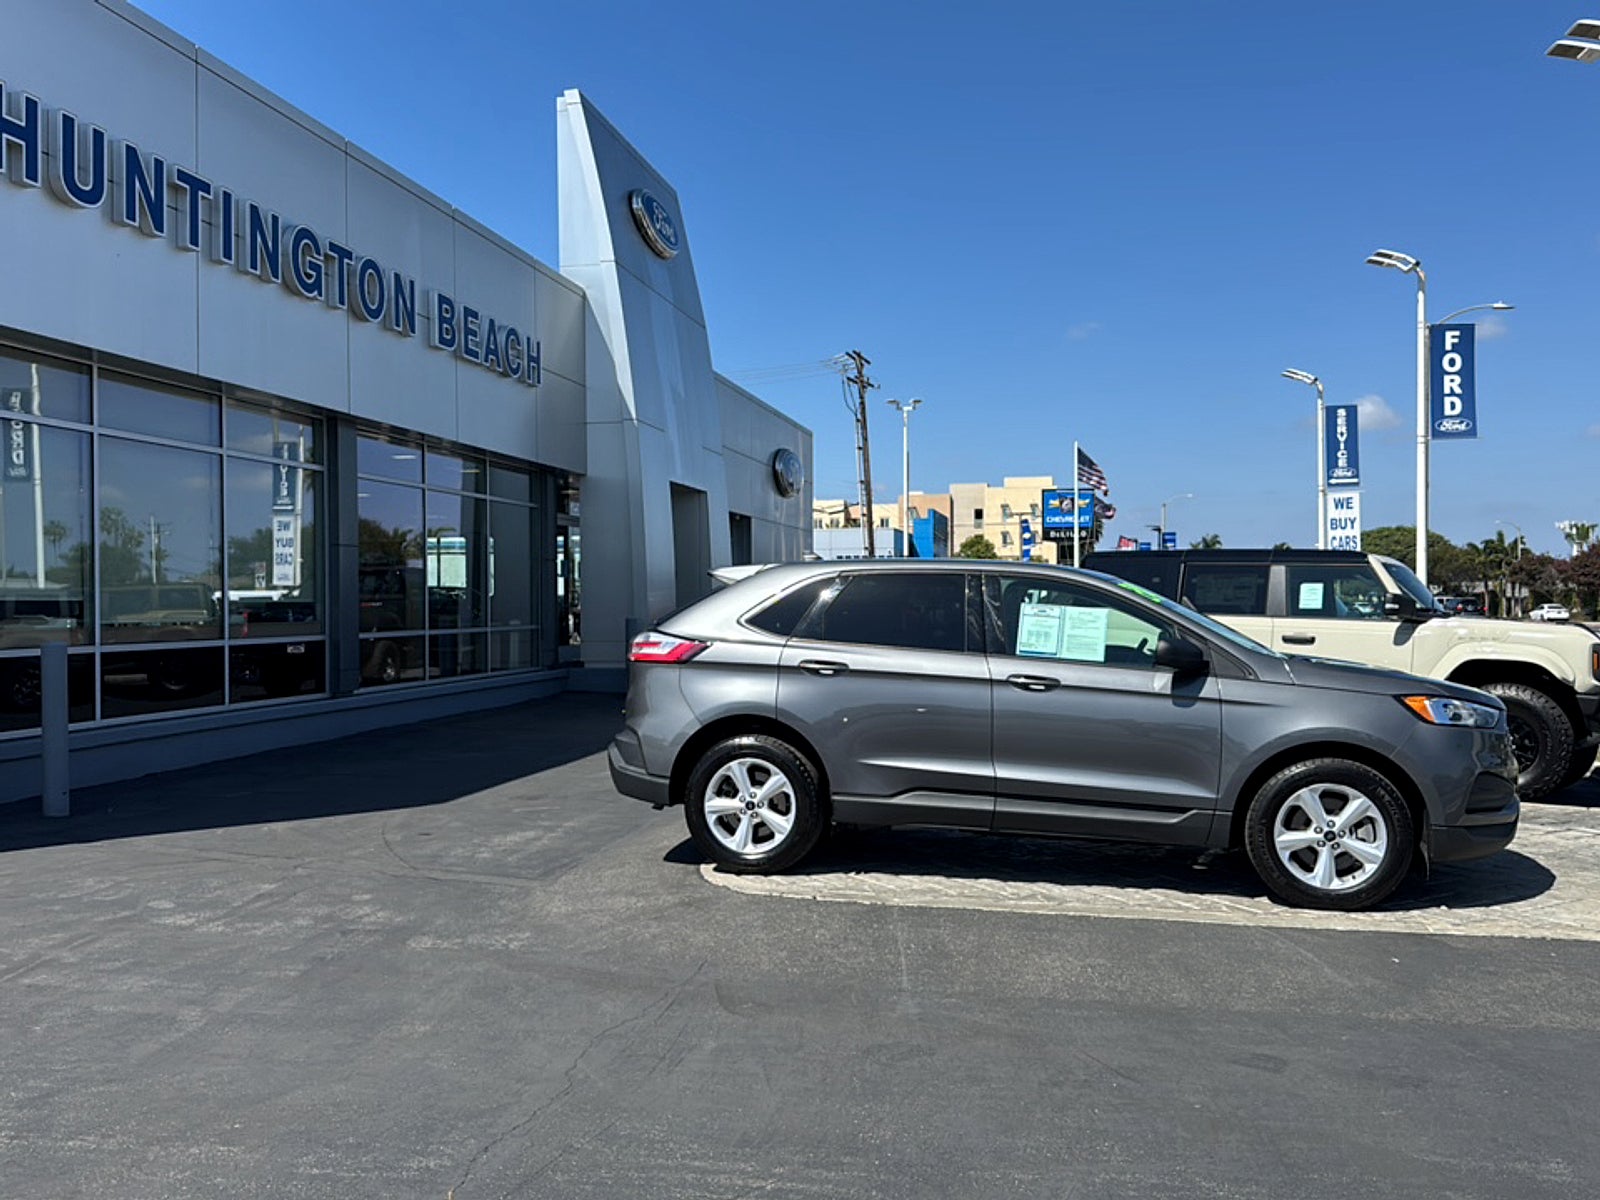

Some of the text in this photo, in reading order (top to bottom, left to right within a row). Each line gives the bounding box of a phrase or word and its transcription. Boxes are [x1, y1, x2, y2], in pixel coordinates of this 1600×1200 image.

[0, 81, 542, 387] HUNTINGTON BEACH
[1441, 329, 1463, 416] FORD
[1439, 419, 1469, 432] Ford
[1336, 408, 1348, 467] SERVICE
[1333, 497, 1354, 509] WE
[1330, 517, 1357, 530] BUY
[1330, 536, 1358, 550] CARS
